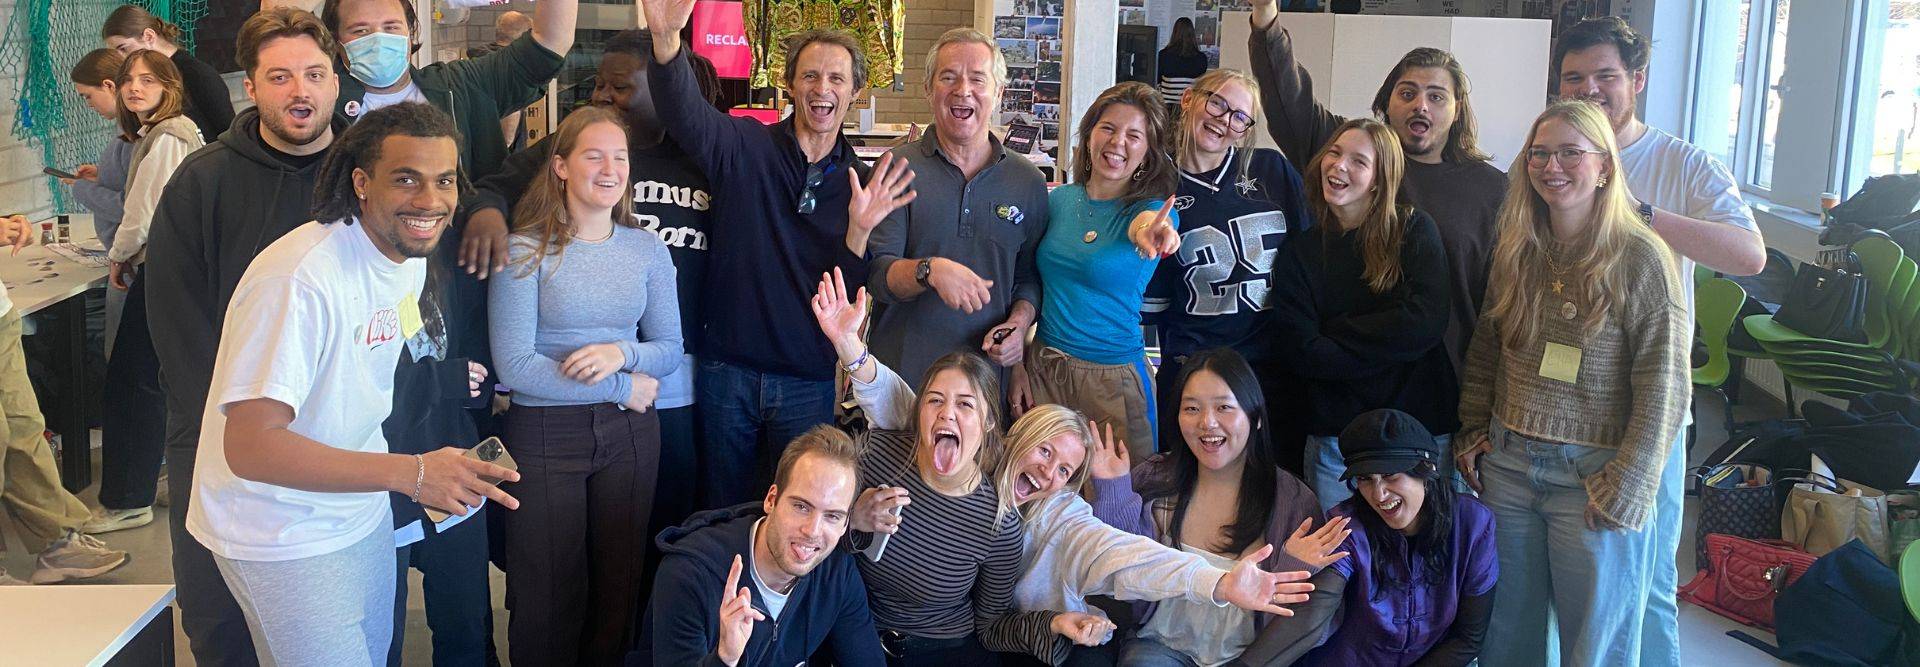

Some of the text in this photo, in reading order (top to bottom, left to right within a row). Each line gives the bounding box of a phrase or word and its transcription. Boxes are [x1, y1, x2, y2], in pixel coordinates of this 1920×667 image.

[706, 33, 749, 46] RECLA
[633, 180, 712, 211] mus
[1175, 211, 1286, 315] 25
